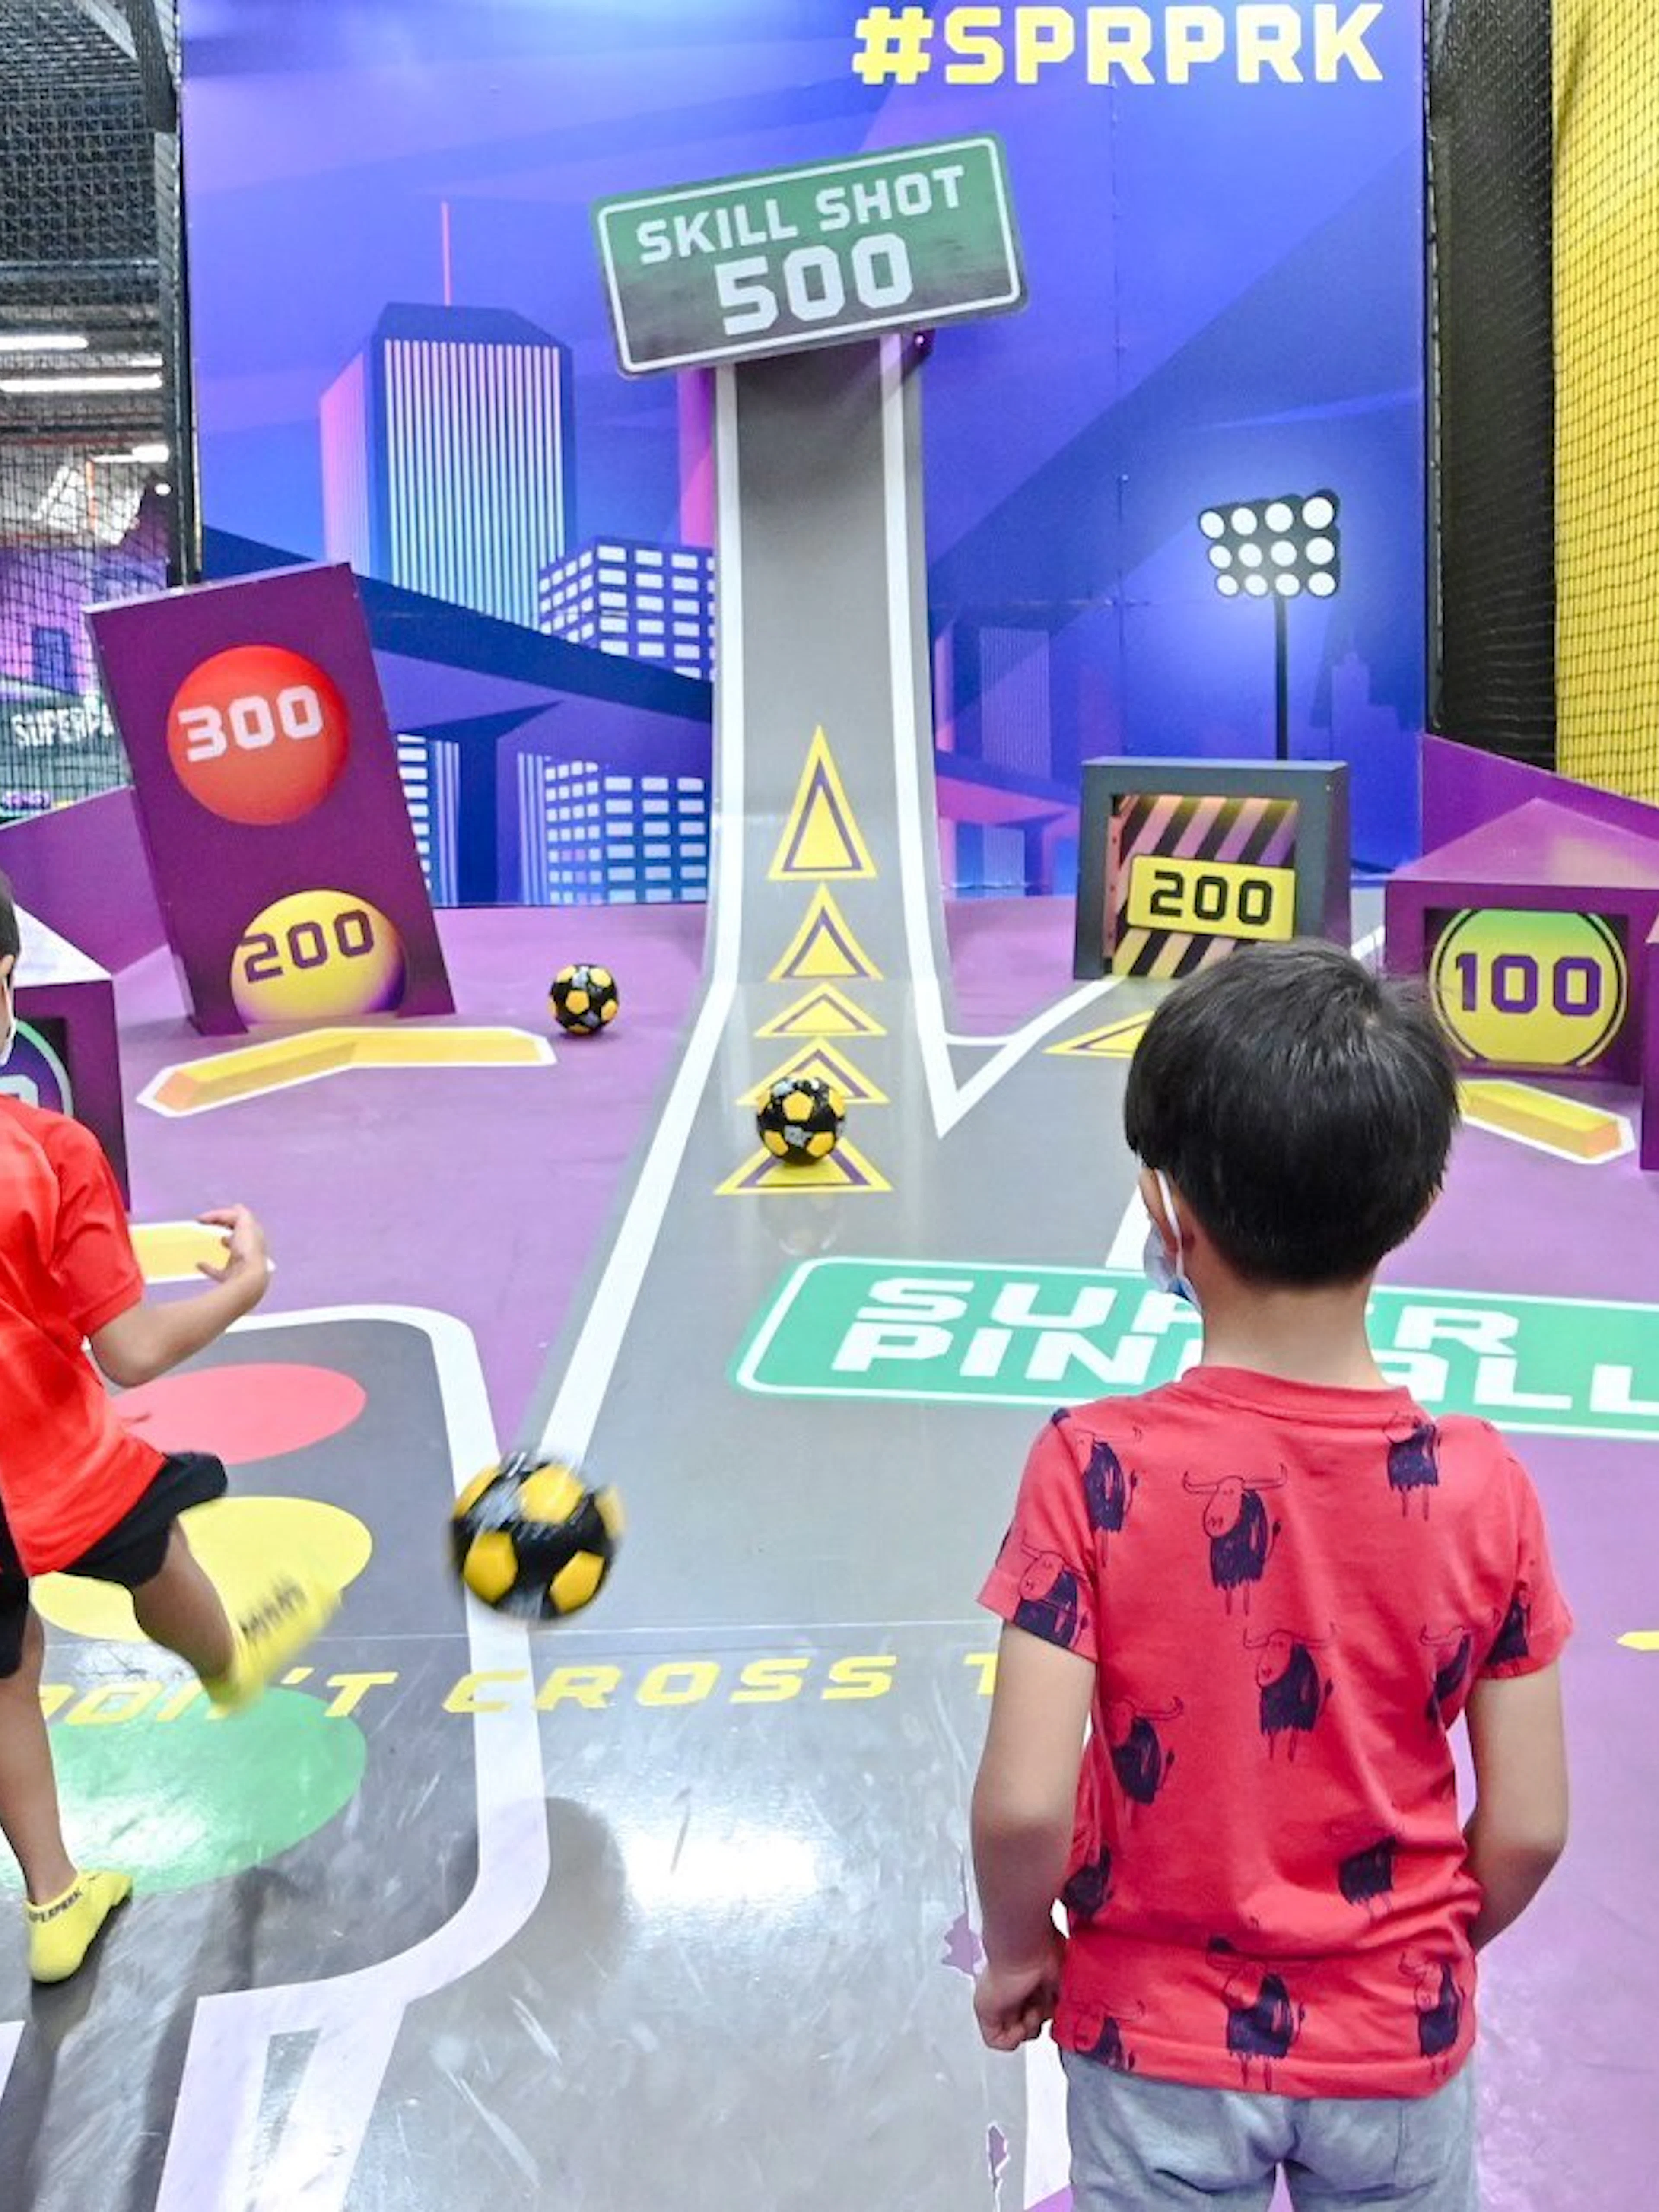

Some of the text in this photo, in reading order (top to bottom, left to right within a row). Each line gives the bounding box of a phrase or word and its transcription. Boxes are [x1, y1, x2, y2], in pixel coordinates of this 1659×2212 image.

[852, 4, 1383, 85] #SPRPRK
[636, 165, 964, 265] SKILL SHOT
[714, 232, 913, 336] 500
[178, 685, 323, 763] 300
[1150, 871, 1273, 926] 200
[242, 909, 374, 983] 200
[1455, 953, 1601, 1017] 100
[442, 1655, 897, 1713] CROSS
